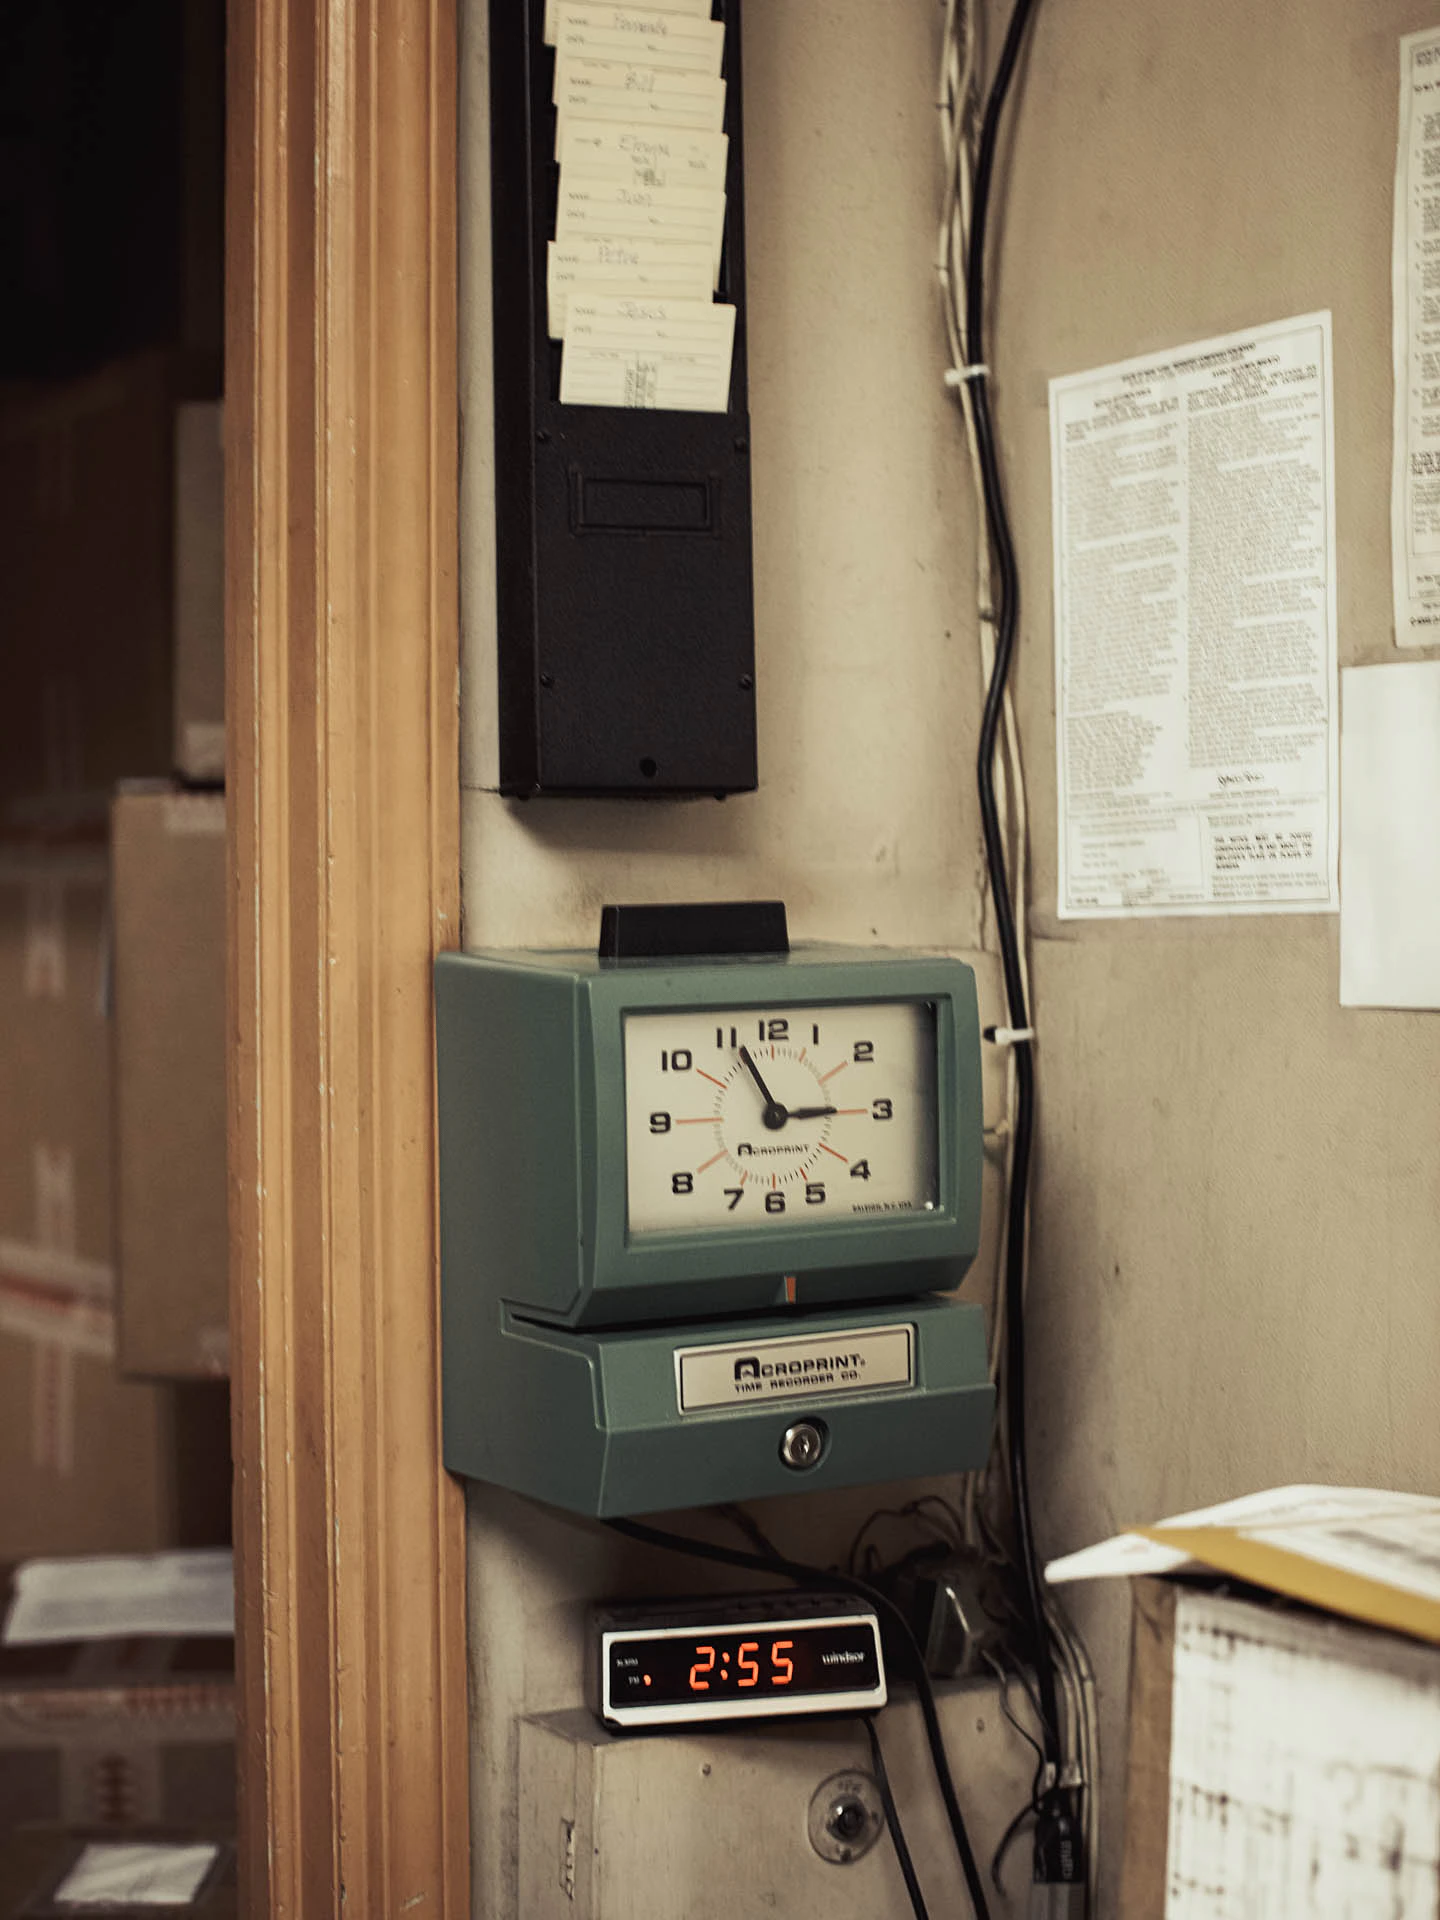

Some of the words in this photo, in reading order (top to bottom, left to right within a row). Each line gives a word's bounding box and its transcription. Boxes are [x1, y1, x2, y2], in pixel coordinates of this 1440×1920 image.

[716, 1027, 738, 1049] 11
[758, 1018, 790, 1042] 12
[812, 1023, 820, 1046] 1
[661, 1049, 693, 1072] 10
[853, 1040, 875, 1063] 2
[872, 1099, 894, 1121] 3
[649, 1111, 672, 1134] 9
[737, 1142, 810, 1157] ACROPRINT
[849, 1158, 871, 1182] 4
[671, 1171, 694, 1195] 8
[805, 1181, 826, 1205] 5
[723, 1188, 745, 1211] 7
[764, 1191, 787, 1214] 6
[734, 1382, 763, 1393] TIME
[770, 1373, 834, 1390] RECORDER
[689, 1640, 794, 1690] 2:55
[628, 1675, 640, 1685] PM
